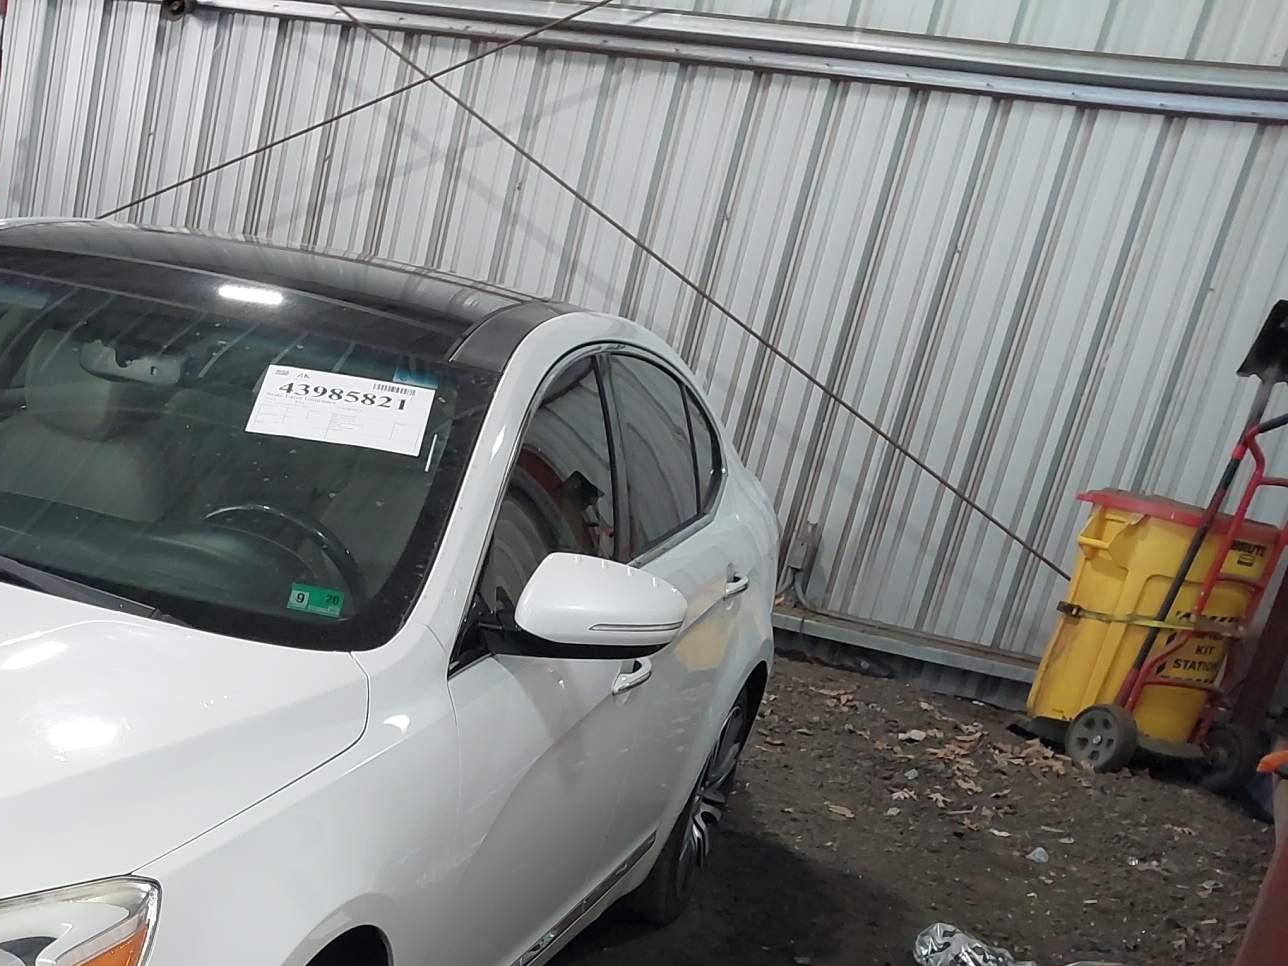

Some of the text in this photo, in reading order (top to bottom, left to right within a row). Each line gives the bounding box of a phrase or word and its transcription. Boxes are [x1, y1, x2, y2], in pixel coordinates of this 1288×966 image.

[279, 381, 407, 410] 43985821
[295, 592, 305, 604] 9
[1194, 645, 1217, 656] KIT
